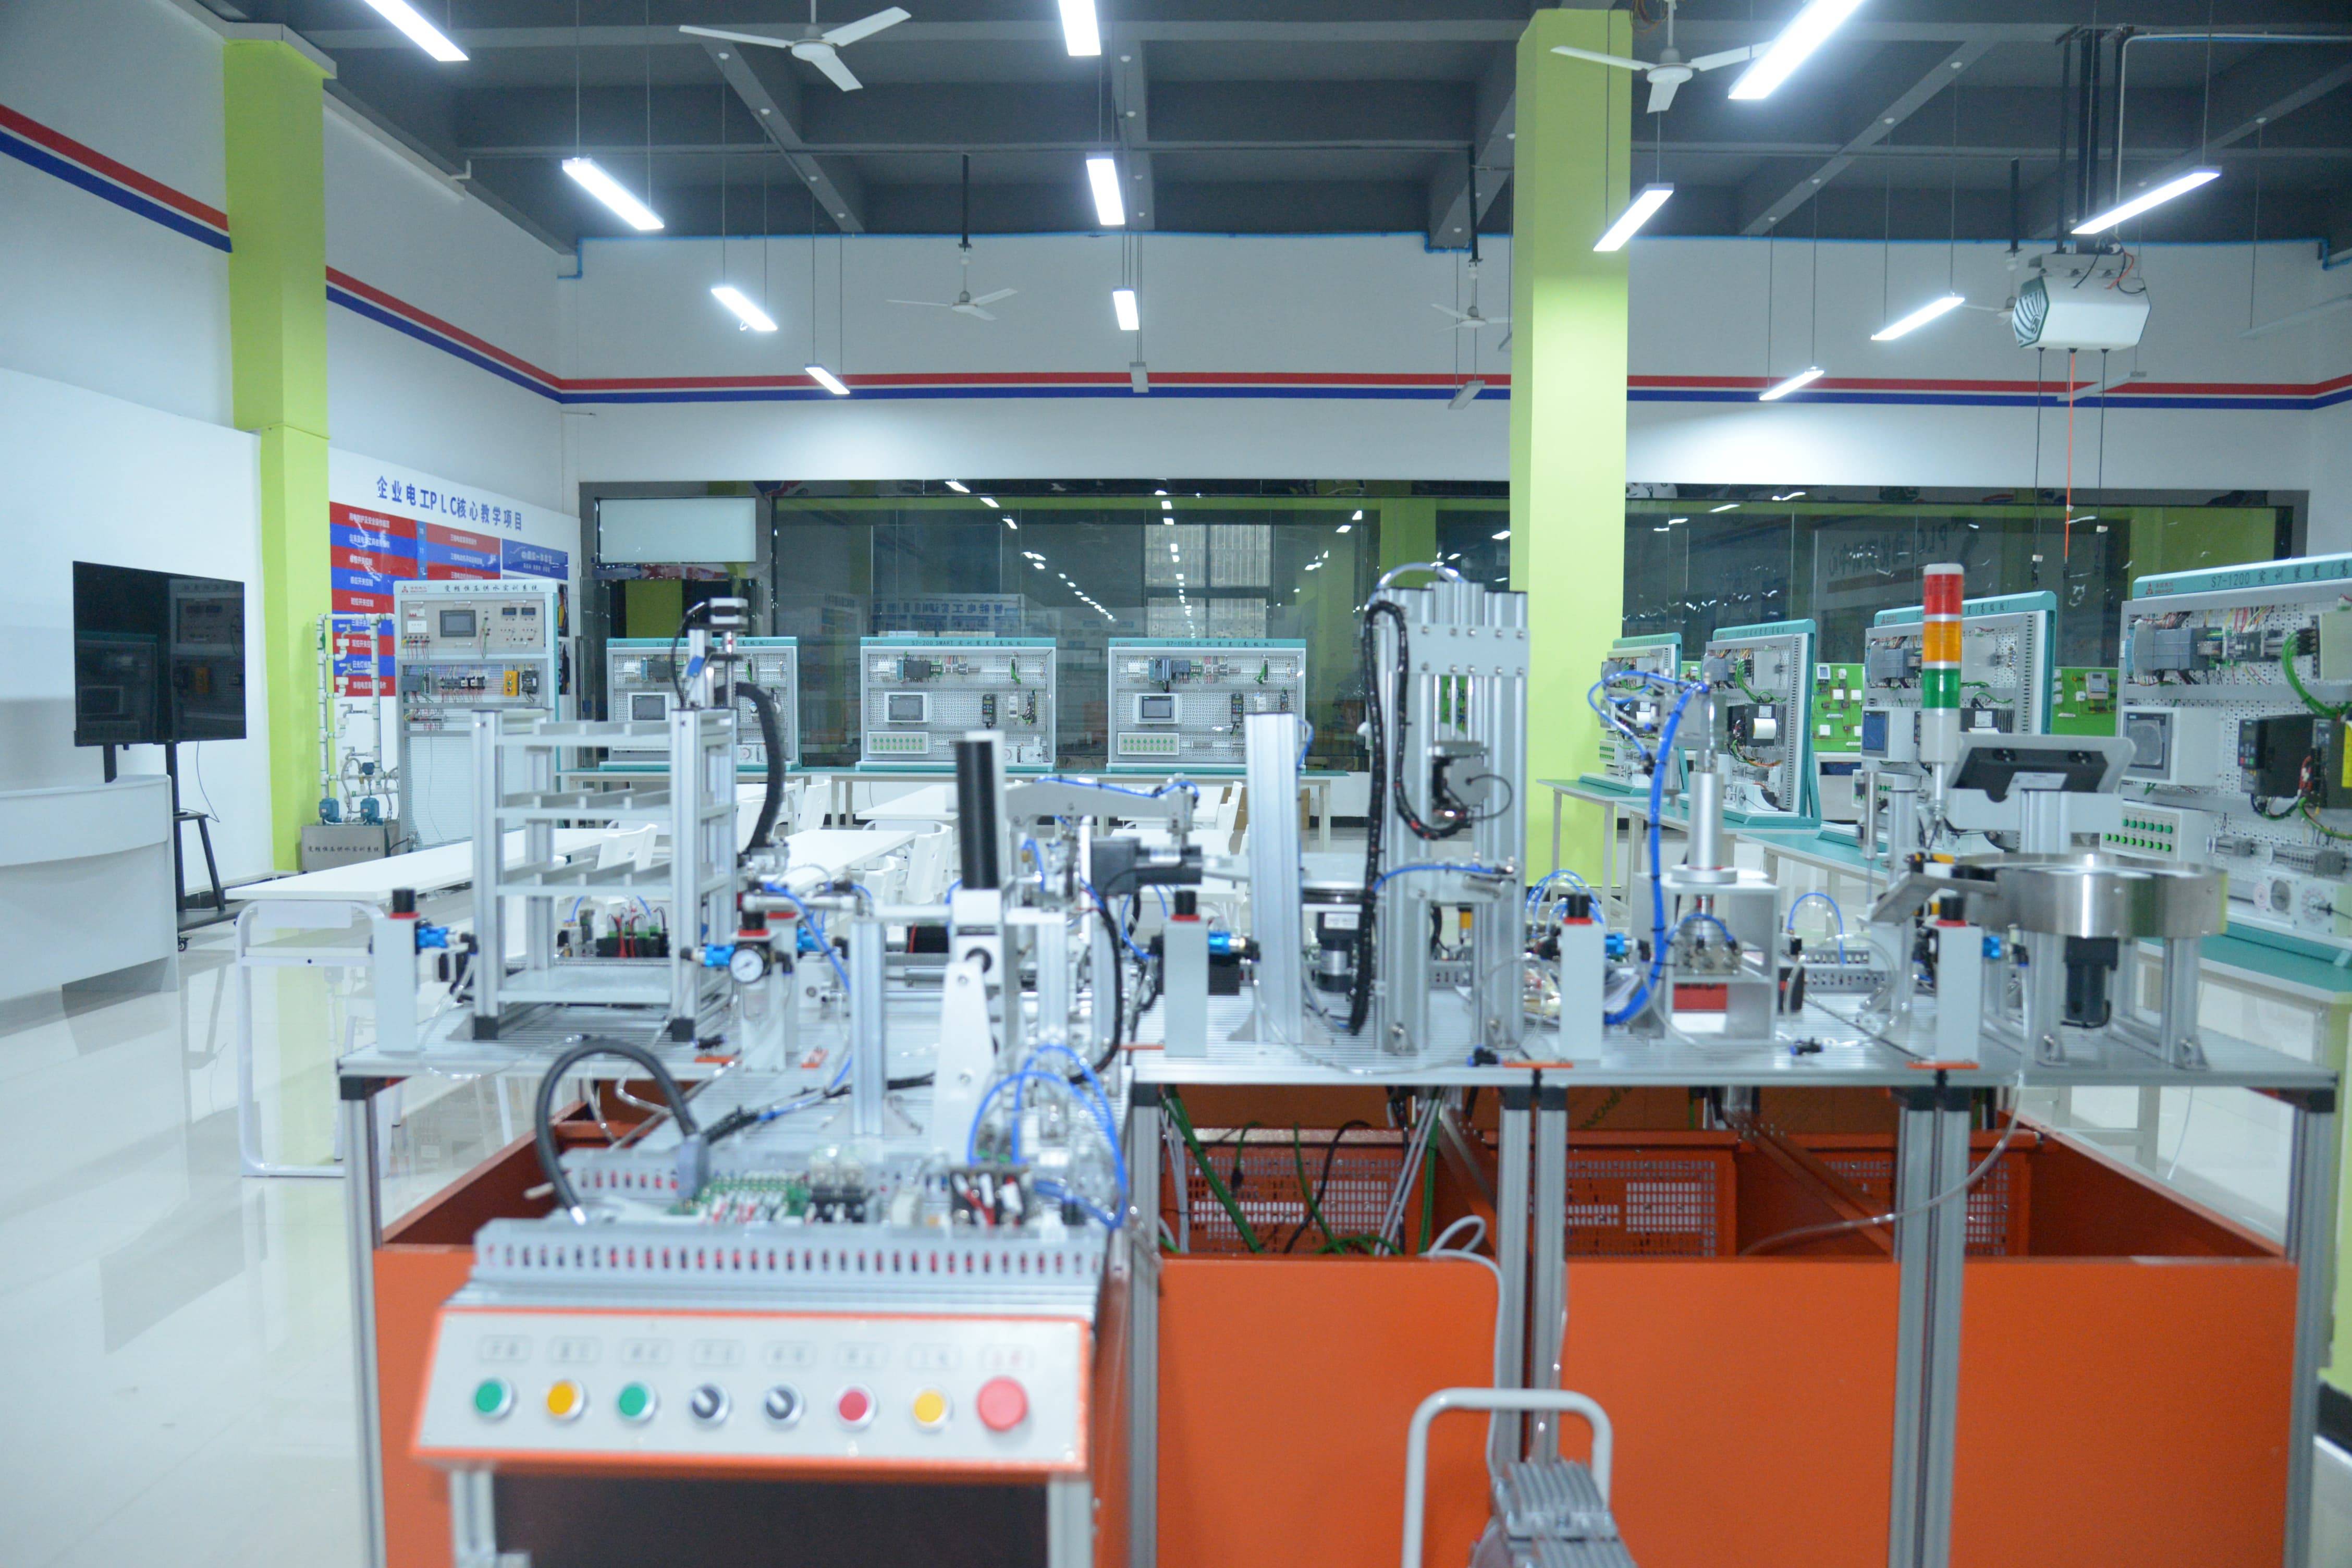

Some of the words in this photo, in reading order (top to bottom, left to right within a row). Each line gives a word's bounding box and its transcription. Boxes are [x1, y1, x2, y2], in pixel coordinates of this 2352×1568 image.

[377, 475, 521, 531] 企业电工PLC核心教学项目
[2211, 572, 2250, 587] S7-1200
